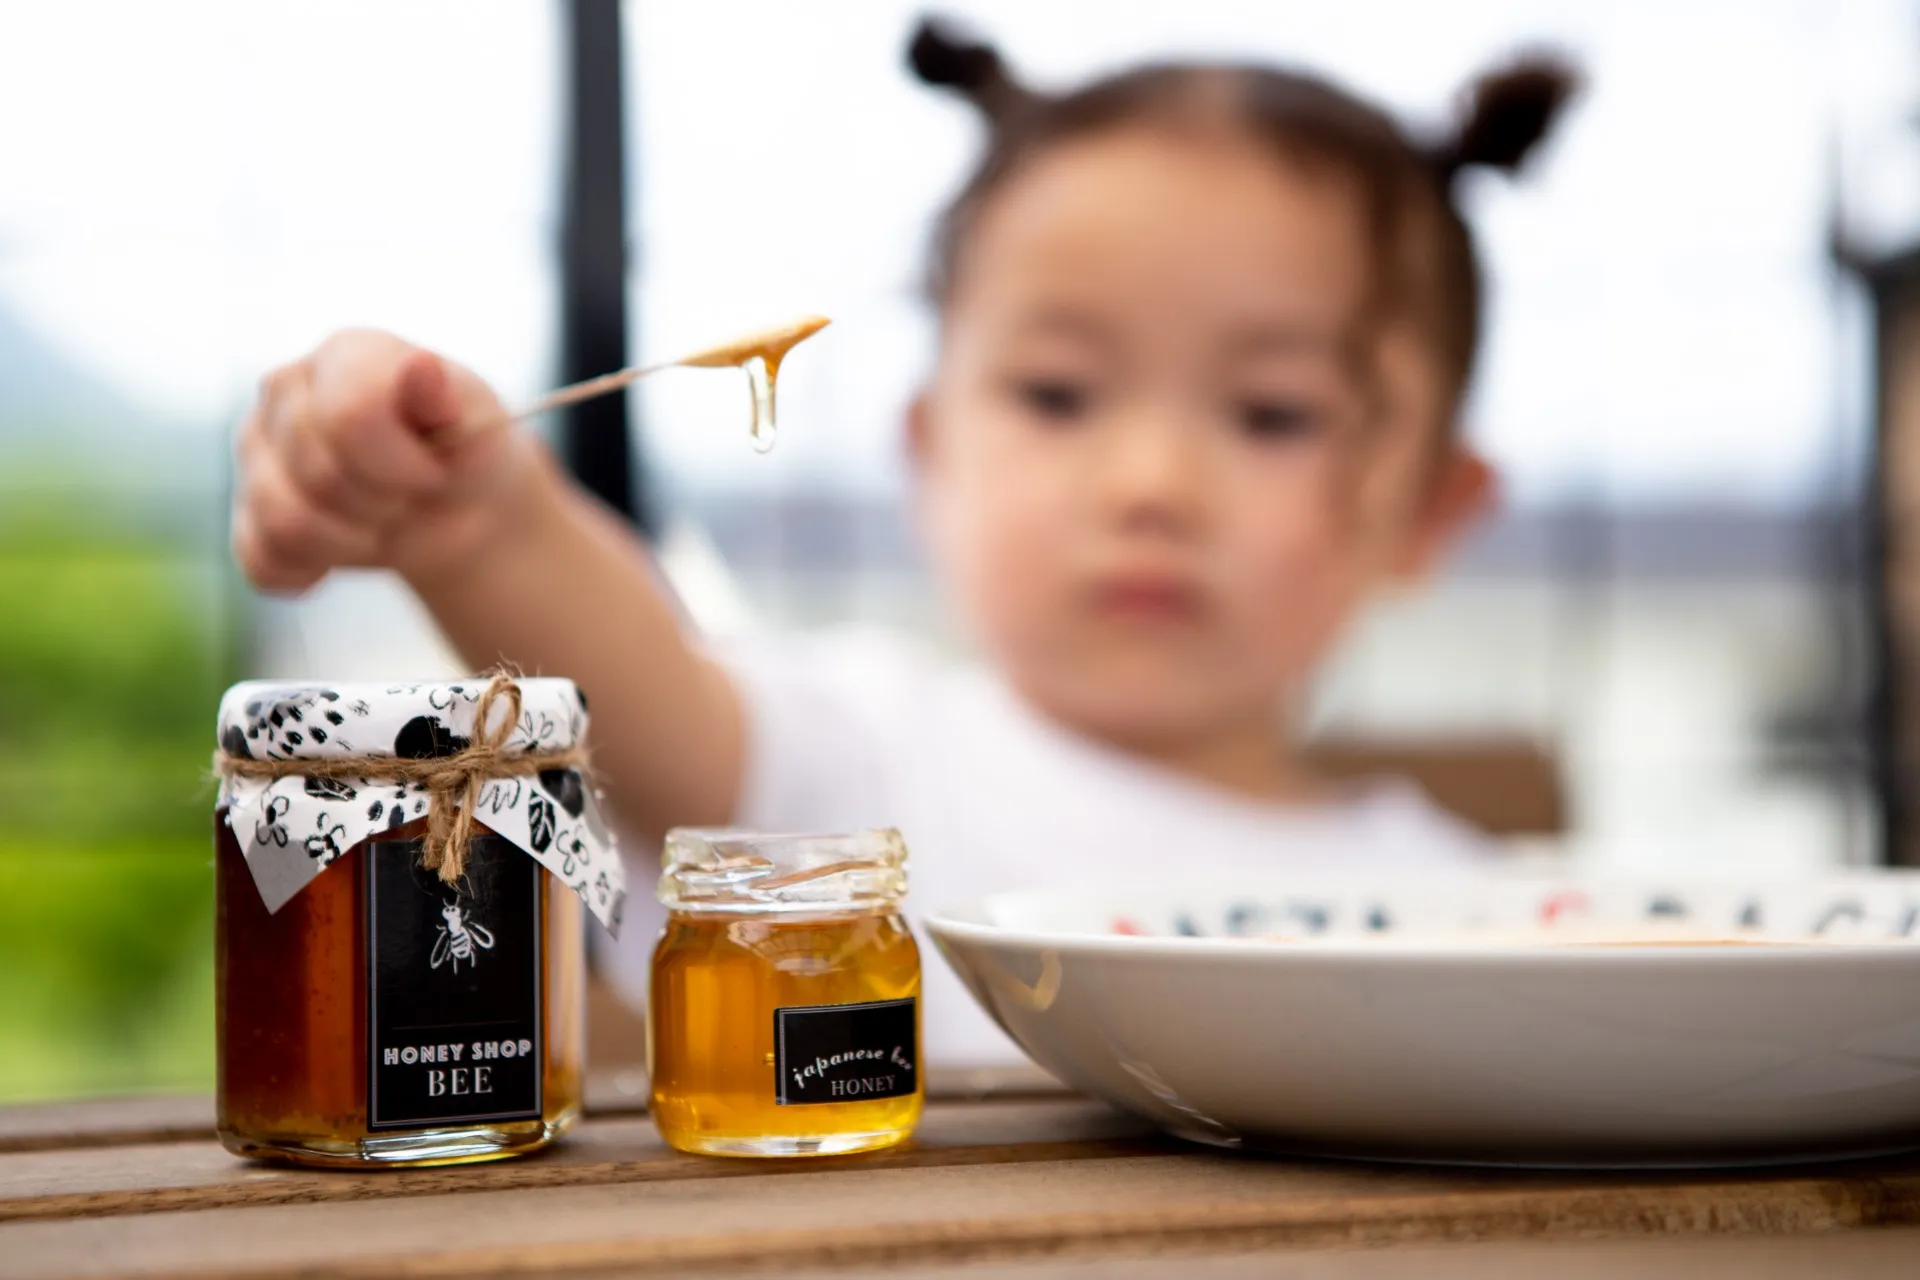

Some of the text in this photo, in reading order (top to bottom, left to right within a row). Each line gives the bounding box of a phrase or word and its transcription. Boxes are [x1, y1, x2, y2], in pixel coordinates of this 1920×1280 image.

[383, 1039, 532, 1065] HONEY SHOP
[427, 1066, 493, 1097] BEE
[792, 1048, 885, 1090] japanese
[831, 1075, 896, 1096] HONEY
